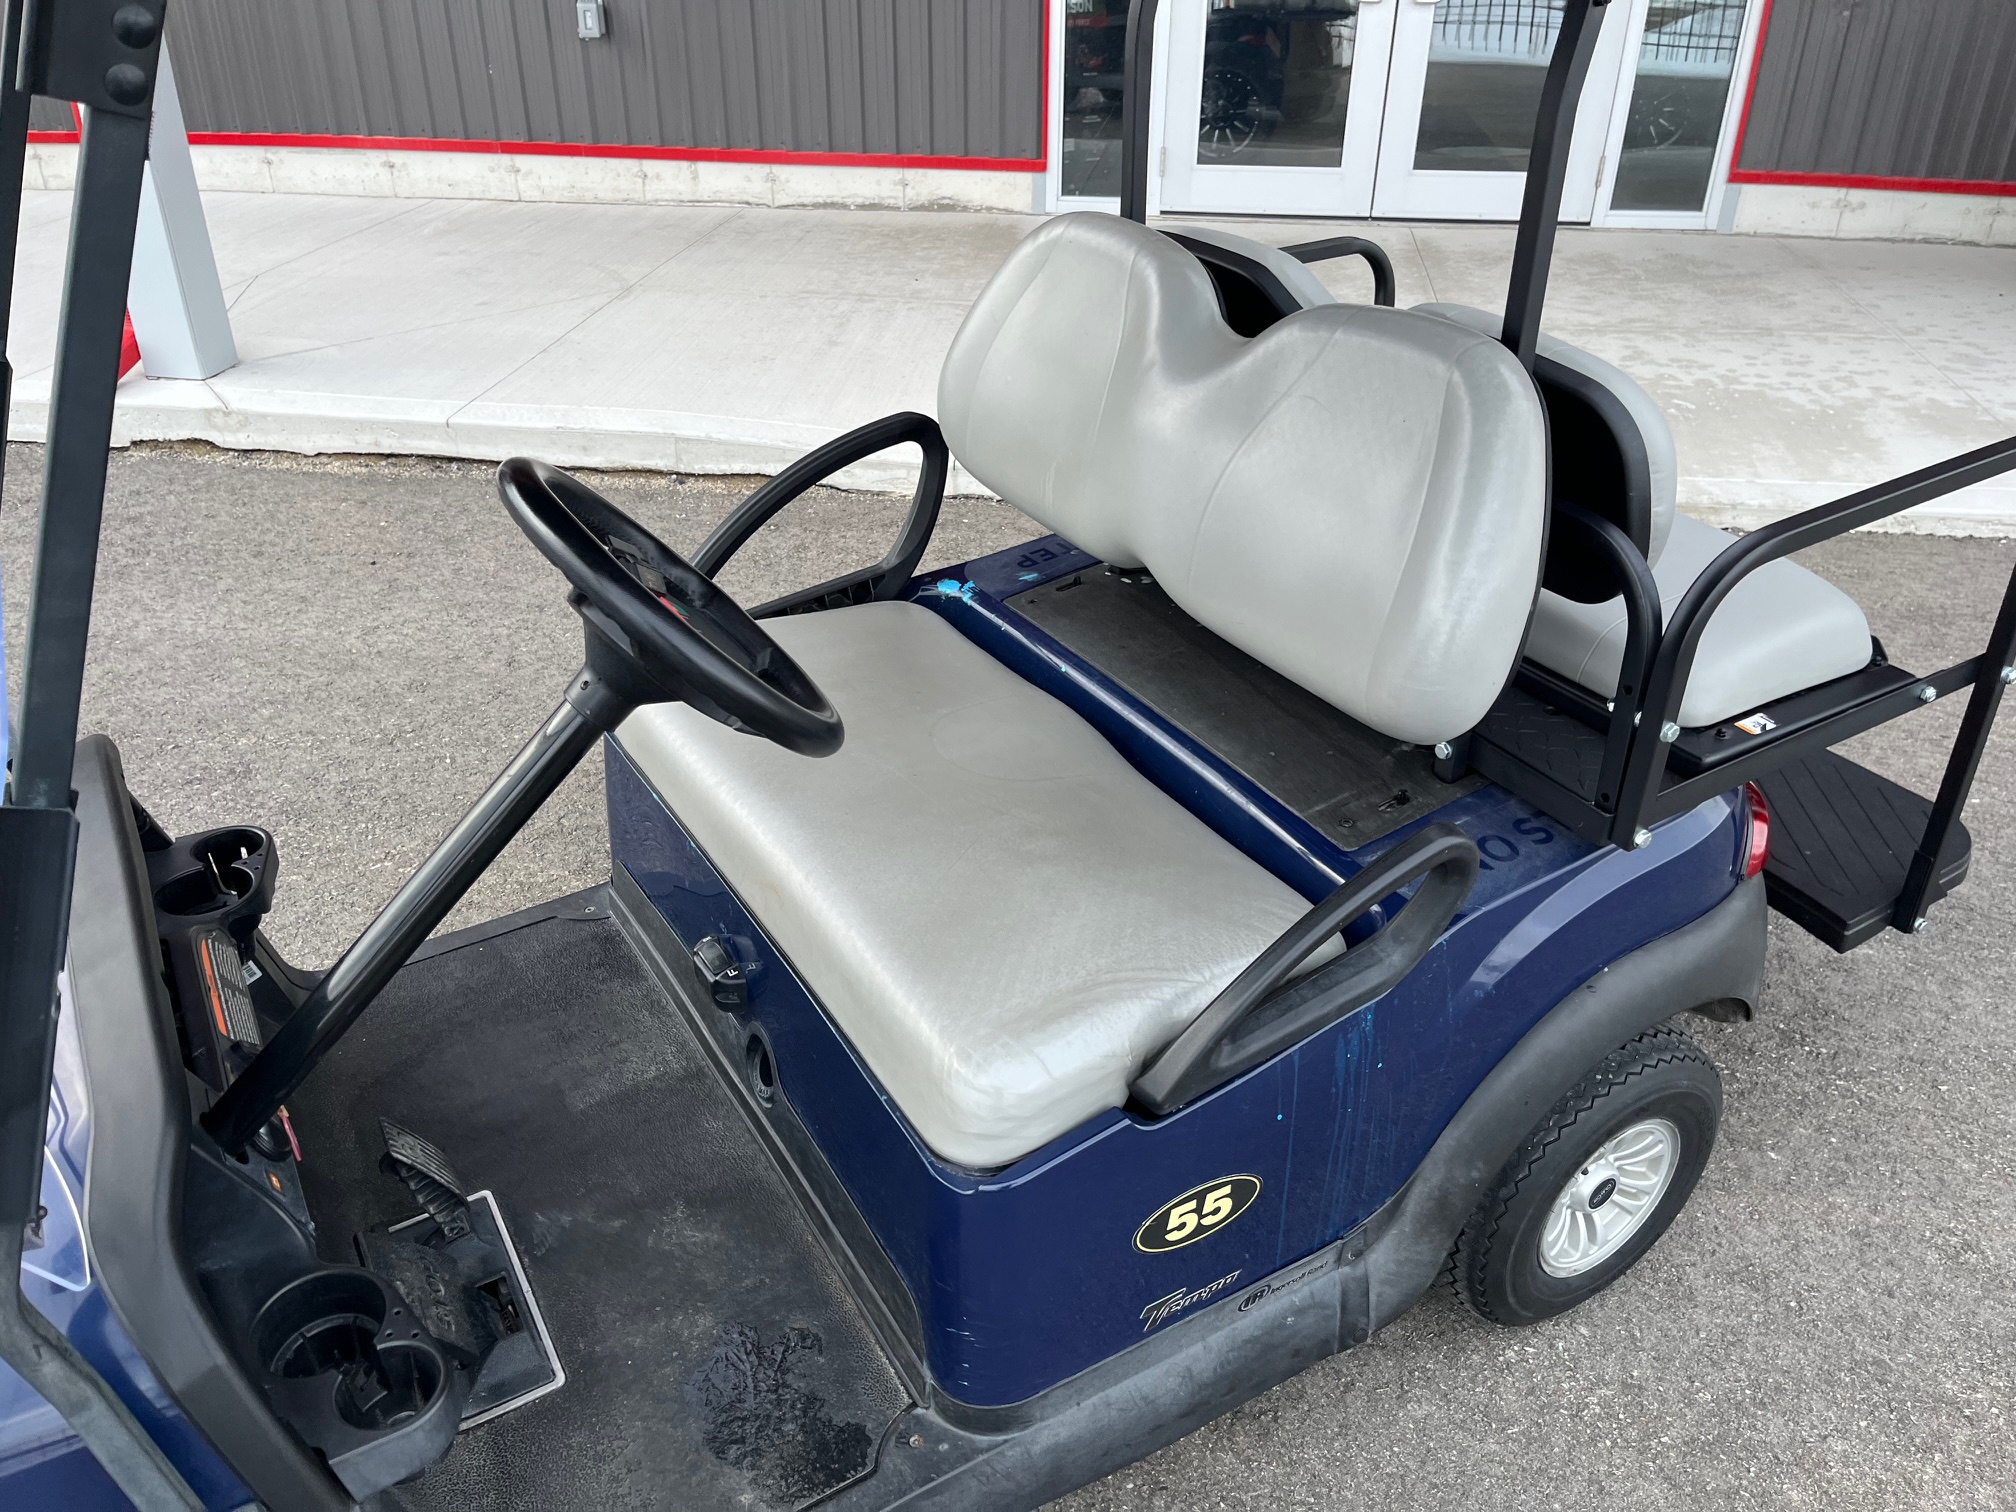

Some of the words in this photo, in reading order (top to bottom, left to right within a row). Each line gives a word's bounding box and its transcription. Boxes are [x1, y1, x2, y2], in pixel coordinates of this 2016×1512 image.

[1067, 0, 1093, 13] SON
[1164, 1184, 1233, 1242] 55
[1140, 1268, 1242, 1332] Tempo
